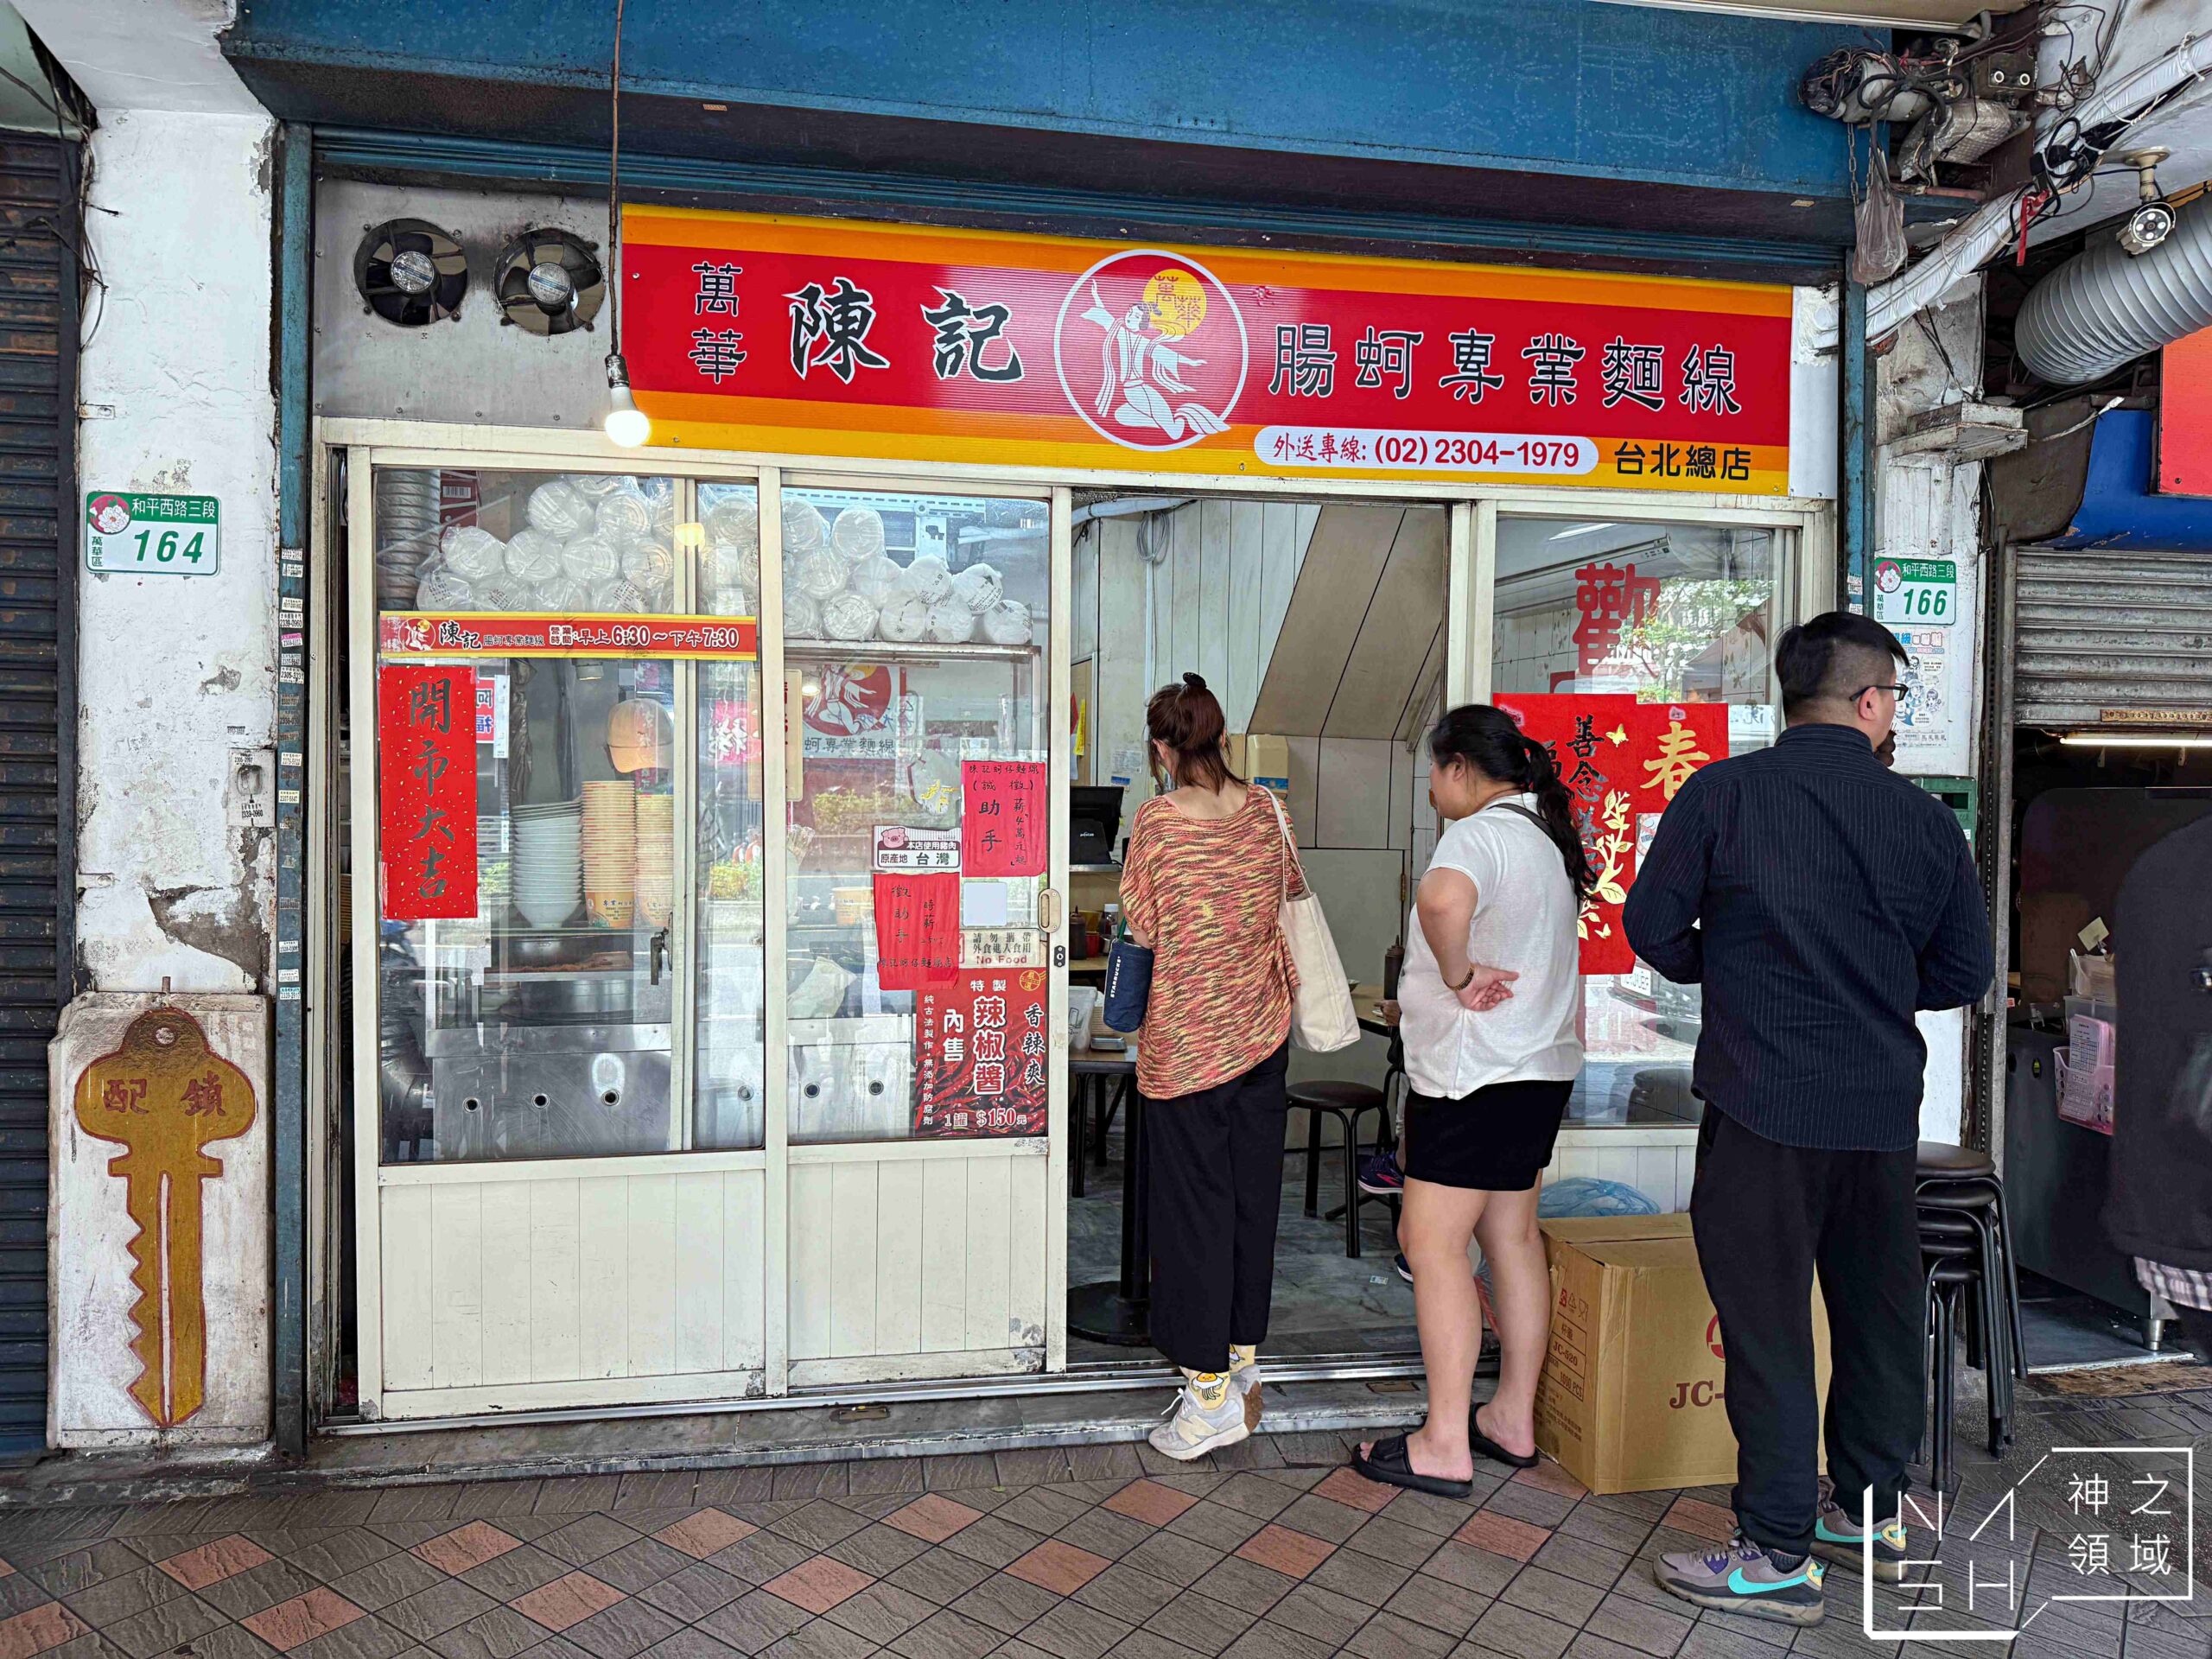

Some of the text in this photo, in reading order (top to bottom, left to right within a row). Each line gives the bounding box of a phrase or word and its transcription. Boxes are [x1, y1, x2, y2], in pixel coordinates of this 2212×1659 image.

[688, 261, 747, 385] 萬華
[781, 276, 1024, 385] 陳記
[1268, 321, 1744, 416] 腸蚵專業麵線
[1613, 442, 1753, 482] 台北總店
[131, 498, 216, 519] 和平西路三段
[92, 536, 104, 568] 萬華區
[133, 529, 204, 564] 164
[1902, 562, 1955, 580] 和平西路三段
[1904, 588, 1948, 616] 166
[438, 620, 483, 651] 陳記
[483, 634, 545, 648] 腸蚵專業麵線
[1640, 721, 1711, 803] 春
[409, 677, 455, 899] 開市大吉
[978, 799, 1003, 852] 助手
[880, 852, 950, 866] 原產地 台灣
[906, 842, 957, 850] 本店使用豬肉
[976, 954, 1027, 964] No Food
[1109, 958, 1122, 999] STARBUCKS
[970, 979, 1007, 992] 特製
[943, 1008, 964, 1062] 內售
[973, 995, 1007, 1096] 辣椒醬
[1022, 1001, 1046, 1085] 香辣爽
[103, 1071, 226, 1117] 配鎖
[1553, 1341, 1578, 1367] JC-520
